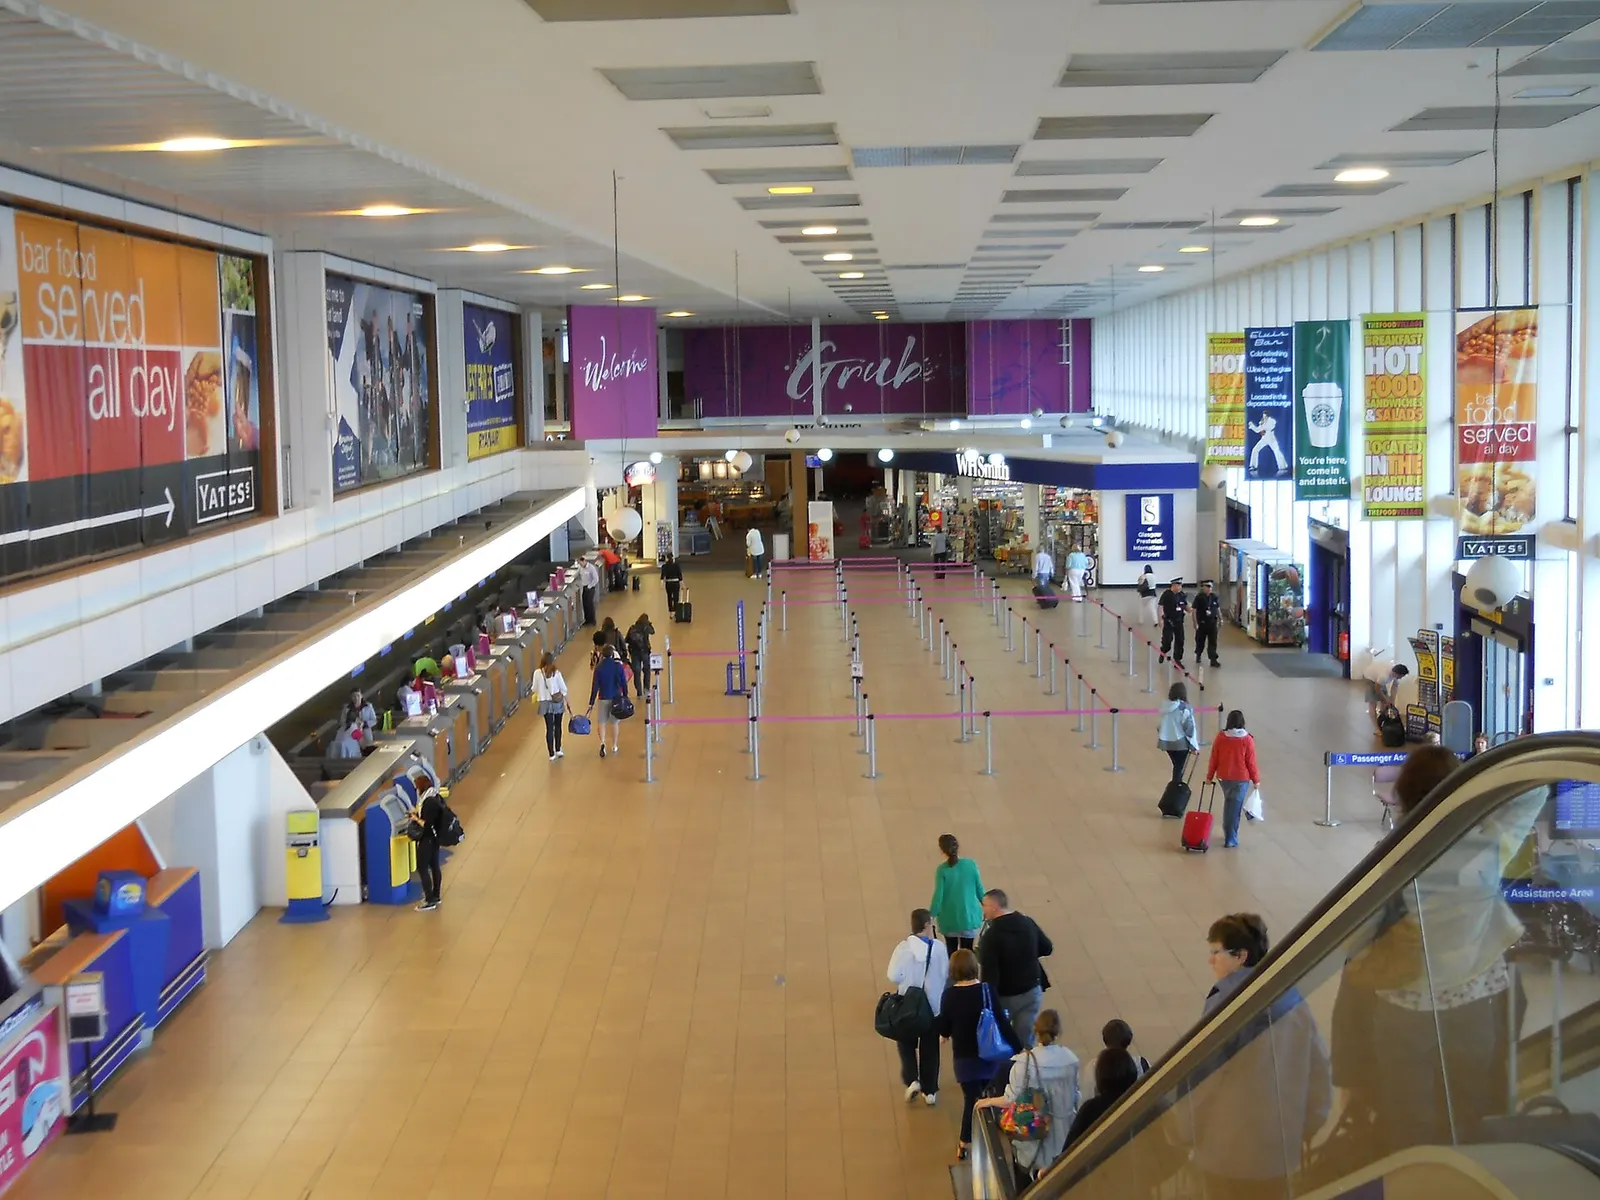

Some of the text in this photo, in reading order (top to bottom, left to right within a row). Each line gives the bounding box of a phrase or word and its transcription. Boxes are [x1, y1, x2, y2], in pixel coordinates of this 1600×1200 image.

[21, 231, 97, 282] bar food
[38, 278, 146, 345] served
[1254, 338, 1284, 346] Bar
[584, 335, 647, 392] Welcome
[786, 335, 922, 400] Grub
[1209, 355, 1245, 373] HOT
[1365, 346, 1422, 375] HOT
[88, 348, 178, 432] all day
[1364, 375, 1423, 398] FOOD
[1464, 402, 1517, 425] food
[1463, 424, 1531, 444] served
[1365, 440, 1423, 454] LOCATED
[1499, 443, 1519, 456] day
[956, 453, 1010, 480] WHSmith
[1300, 457, 1347, 465] You're here,
[1307, 467, 1339, 475] come in
[1299, 477, 1347, 486] and taste it.
[1365, 486, 1423, 502] LOUNGE
[1352, 754, 1391, 765] Passenger
[1511, 888, 1567, 898] Assistance
[1569, 888, 1594, 897] Area
